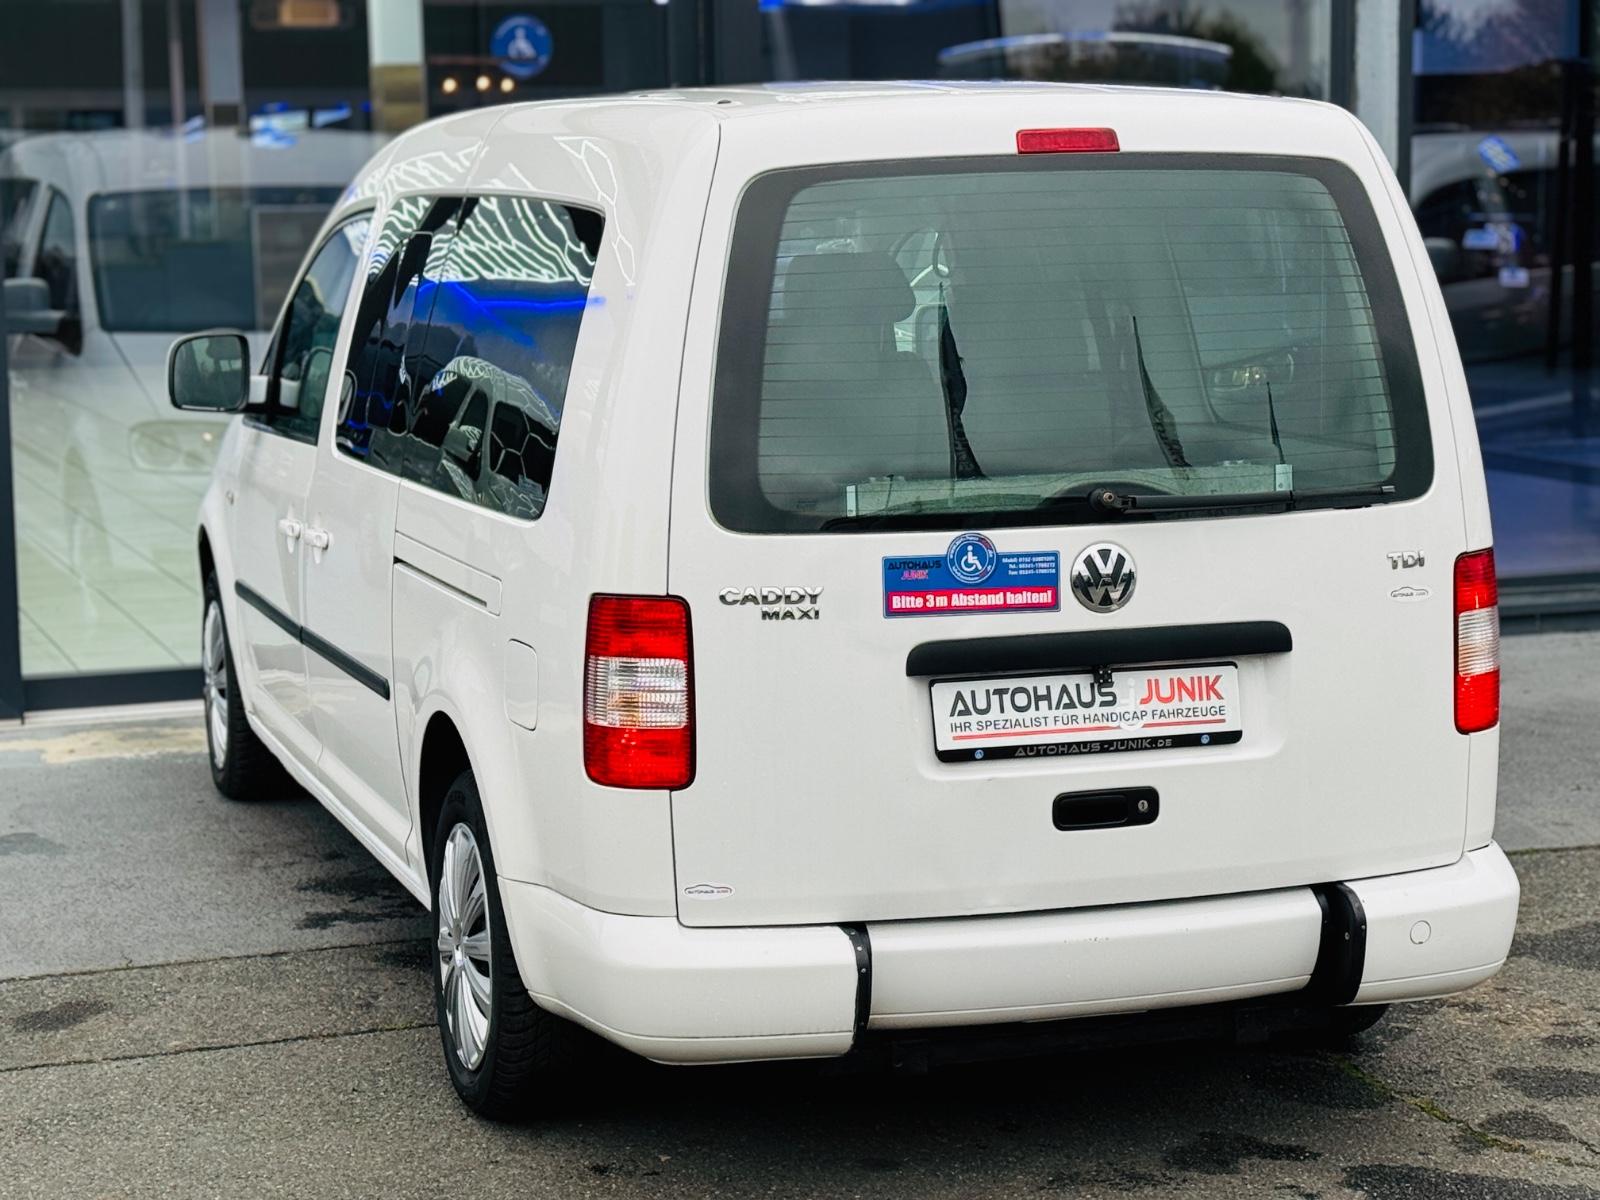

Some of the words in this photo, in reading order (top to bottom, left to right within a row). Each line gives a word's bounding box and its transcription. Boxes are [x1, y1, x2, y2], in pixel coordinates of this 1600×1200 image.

[888, 560, 942, 570] AUTOHAUS
[1387, 551, 1425, 570] TDI
[719, 586, 824, 605] CADDY
[892, 595, 923, 609] Bitte
[951, 592, 1005, 607] Abstand
[761, 607, 820, 620] MAXI
[949, 682, 1117, 718] AUTOHAUS
[1139, 674, 1224, 705] JUNIK
[950, 723, 973, 734] IHR
[976, 716, 1049, 732] SPEZIALIST
[1053, 714, 1080, 728] FÜR
[1084, 711, 1149, 726] HANDICAP
[1151, 705, 1227, 721] FAHRZEUGE
